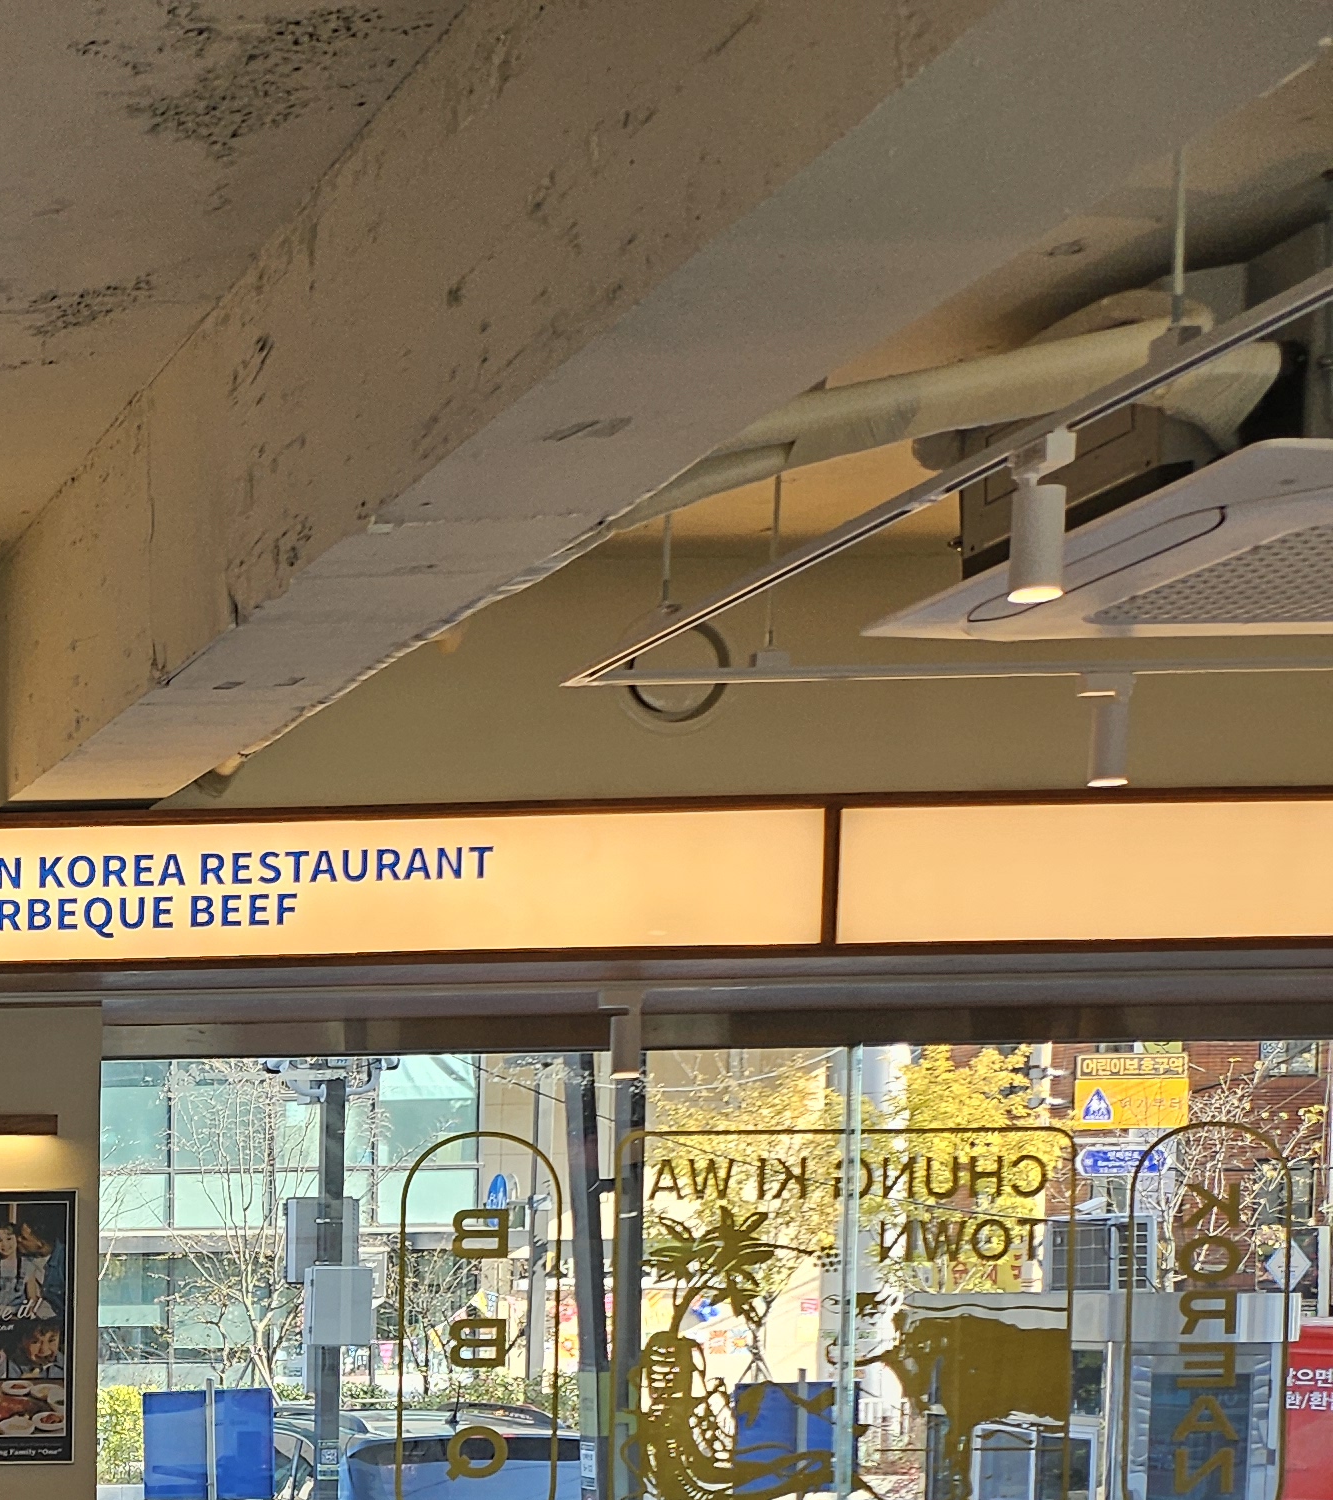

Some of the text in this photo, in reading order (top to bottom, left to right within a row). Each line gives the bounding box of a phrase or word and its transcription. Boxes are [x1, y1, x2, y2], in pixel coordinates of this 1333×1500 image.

[38, 853, 186, 889] KOREA
[200, 845, 495, 886] RESTAURANT
[189, 893, 298, 928] BEEF
[1082, 1058, 1184, 1076] 어린이보호구역
[17, 1297, 43, 1320] it!
[9, 1448, 37, 1458] Family
